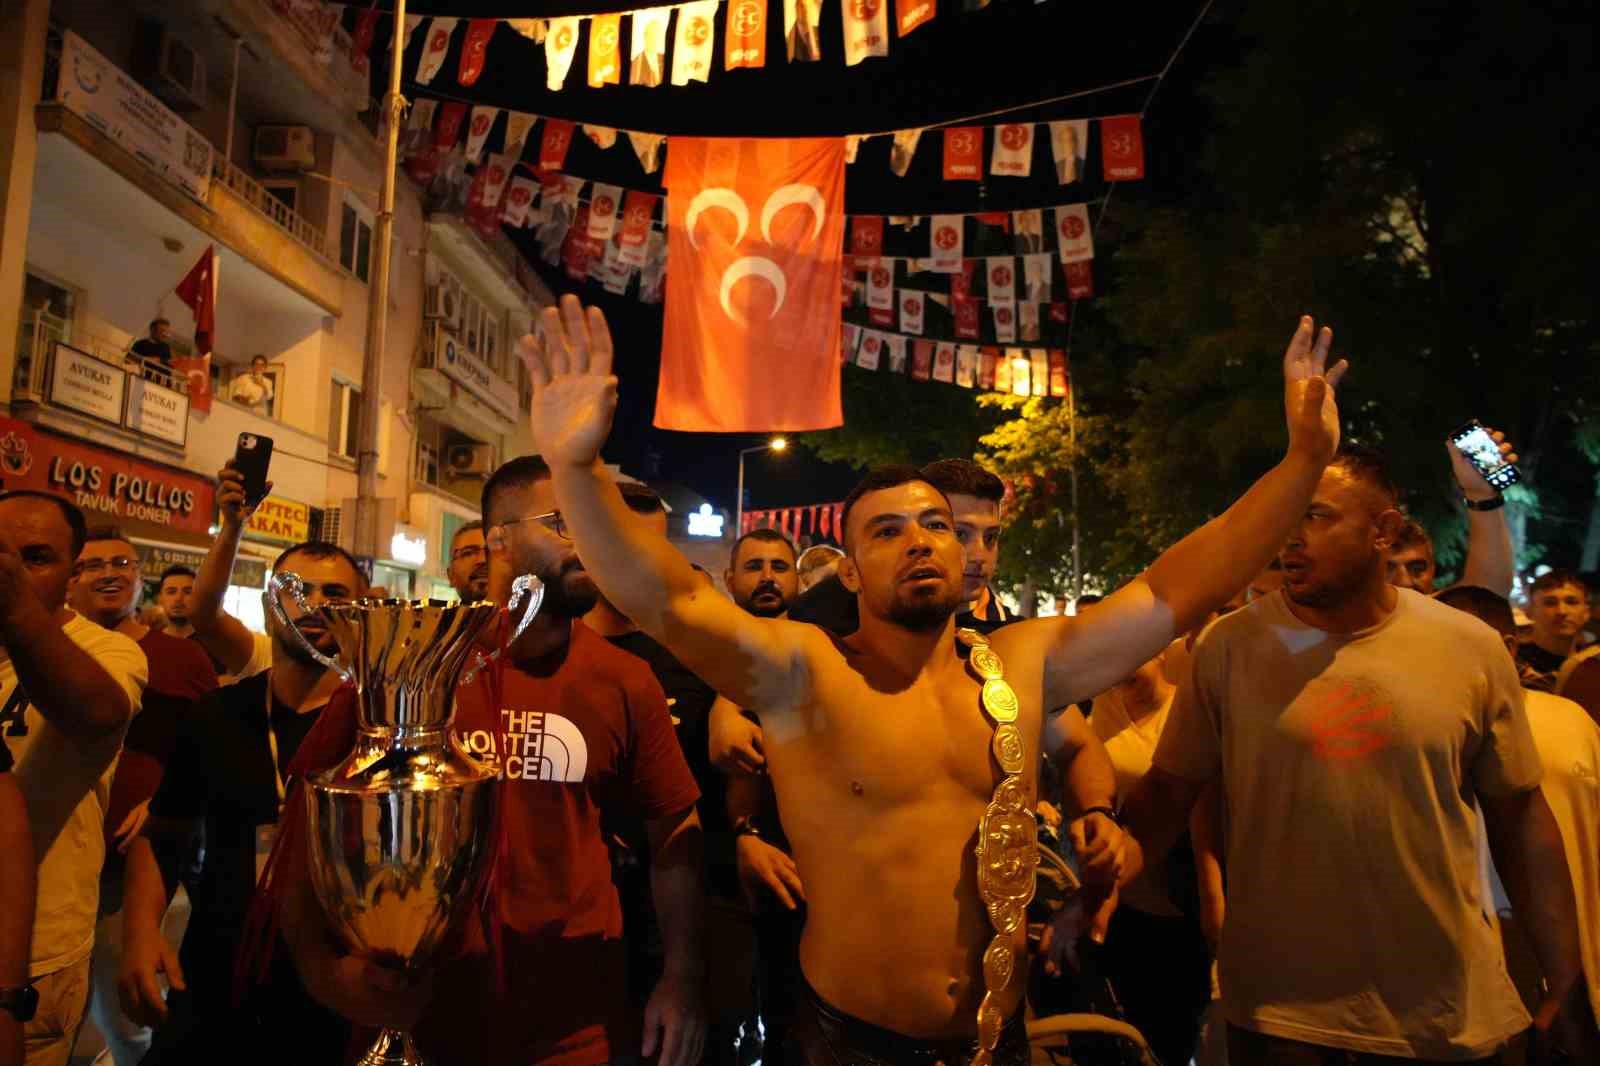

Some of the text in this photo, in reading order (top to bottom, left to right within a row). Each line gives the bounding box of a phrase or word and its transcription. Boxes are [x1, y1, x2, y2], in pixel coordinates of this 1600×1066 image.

[70, 362, 112, 385] AVUKAT
[53, 457, 195, 512] LOS POLLOS
[75, 490, 119, 514] TAVUK
[481, 753, 539, 780] FCE
